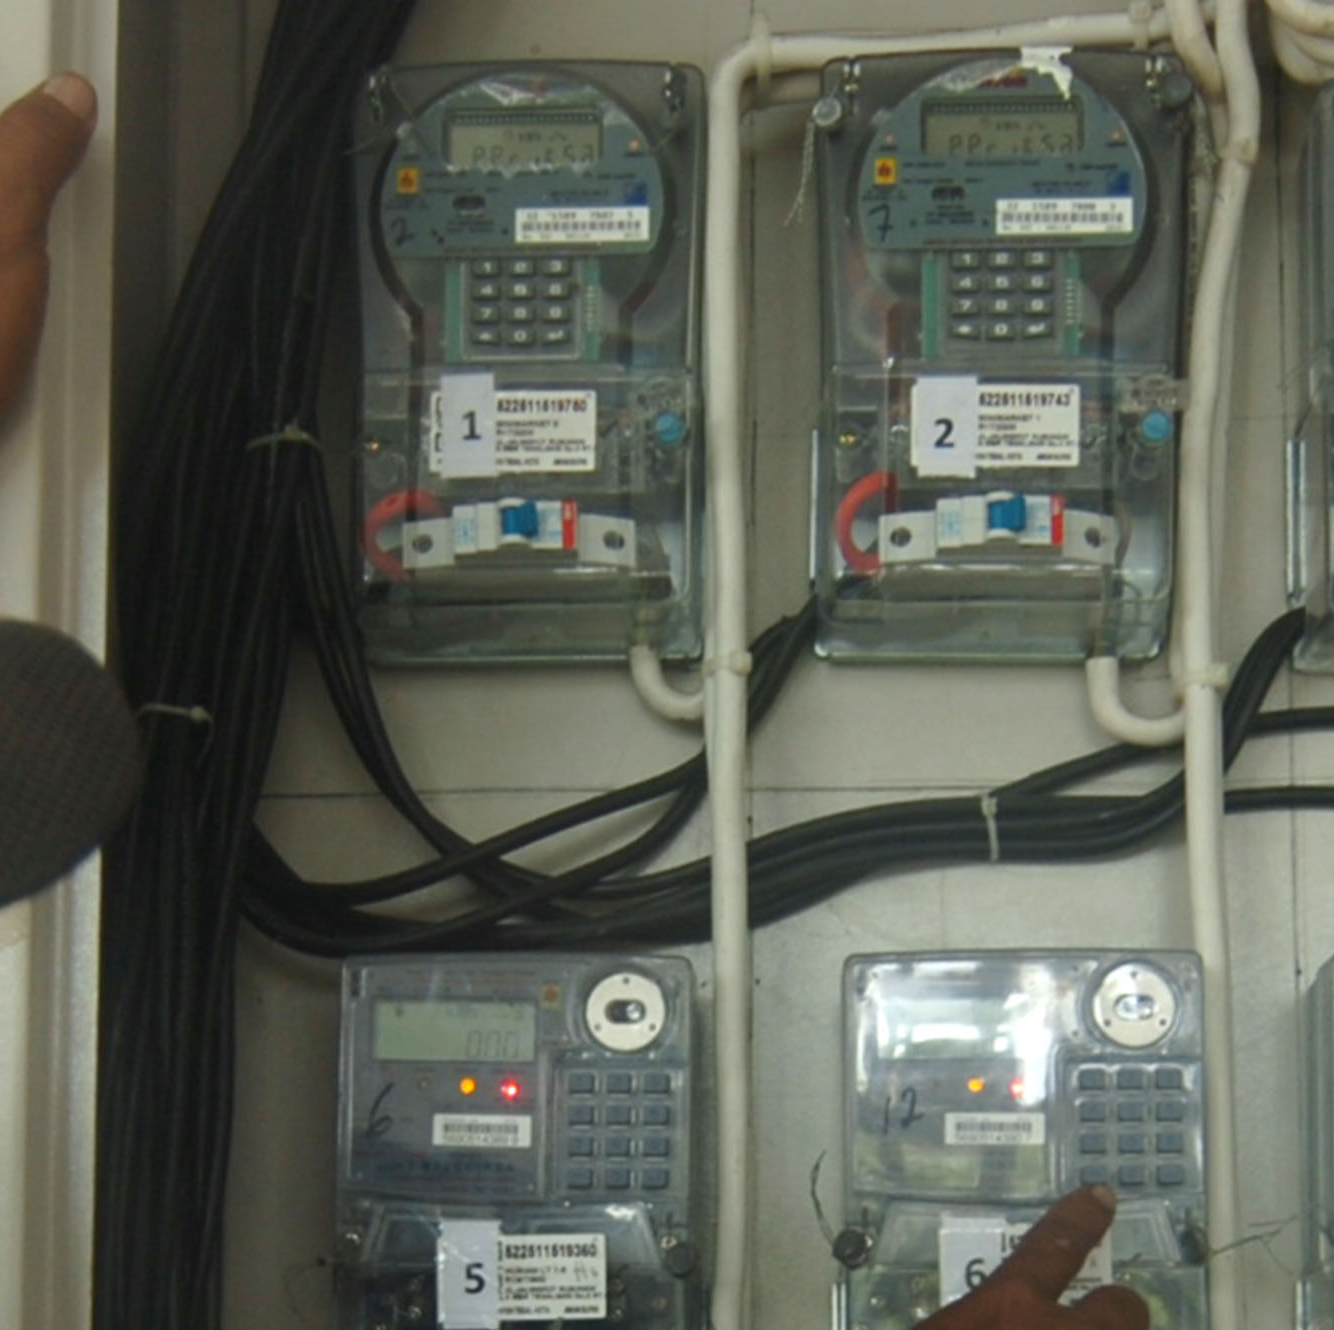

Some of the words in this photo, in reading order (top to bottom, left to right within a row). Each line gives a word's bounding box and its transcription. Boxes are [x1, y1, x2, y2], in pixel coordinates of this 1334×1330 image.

[461, 409, 482, 441] 1
[933, 417, 955, 449] 2
[878, 1086, 927, 1135] 12
[463, 1262, 486, 1295] 5
[964, 1257, 987, 1289] 6
